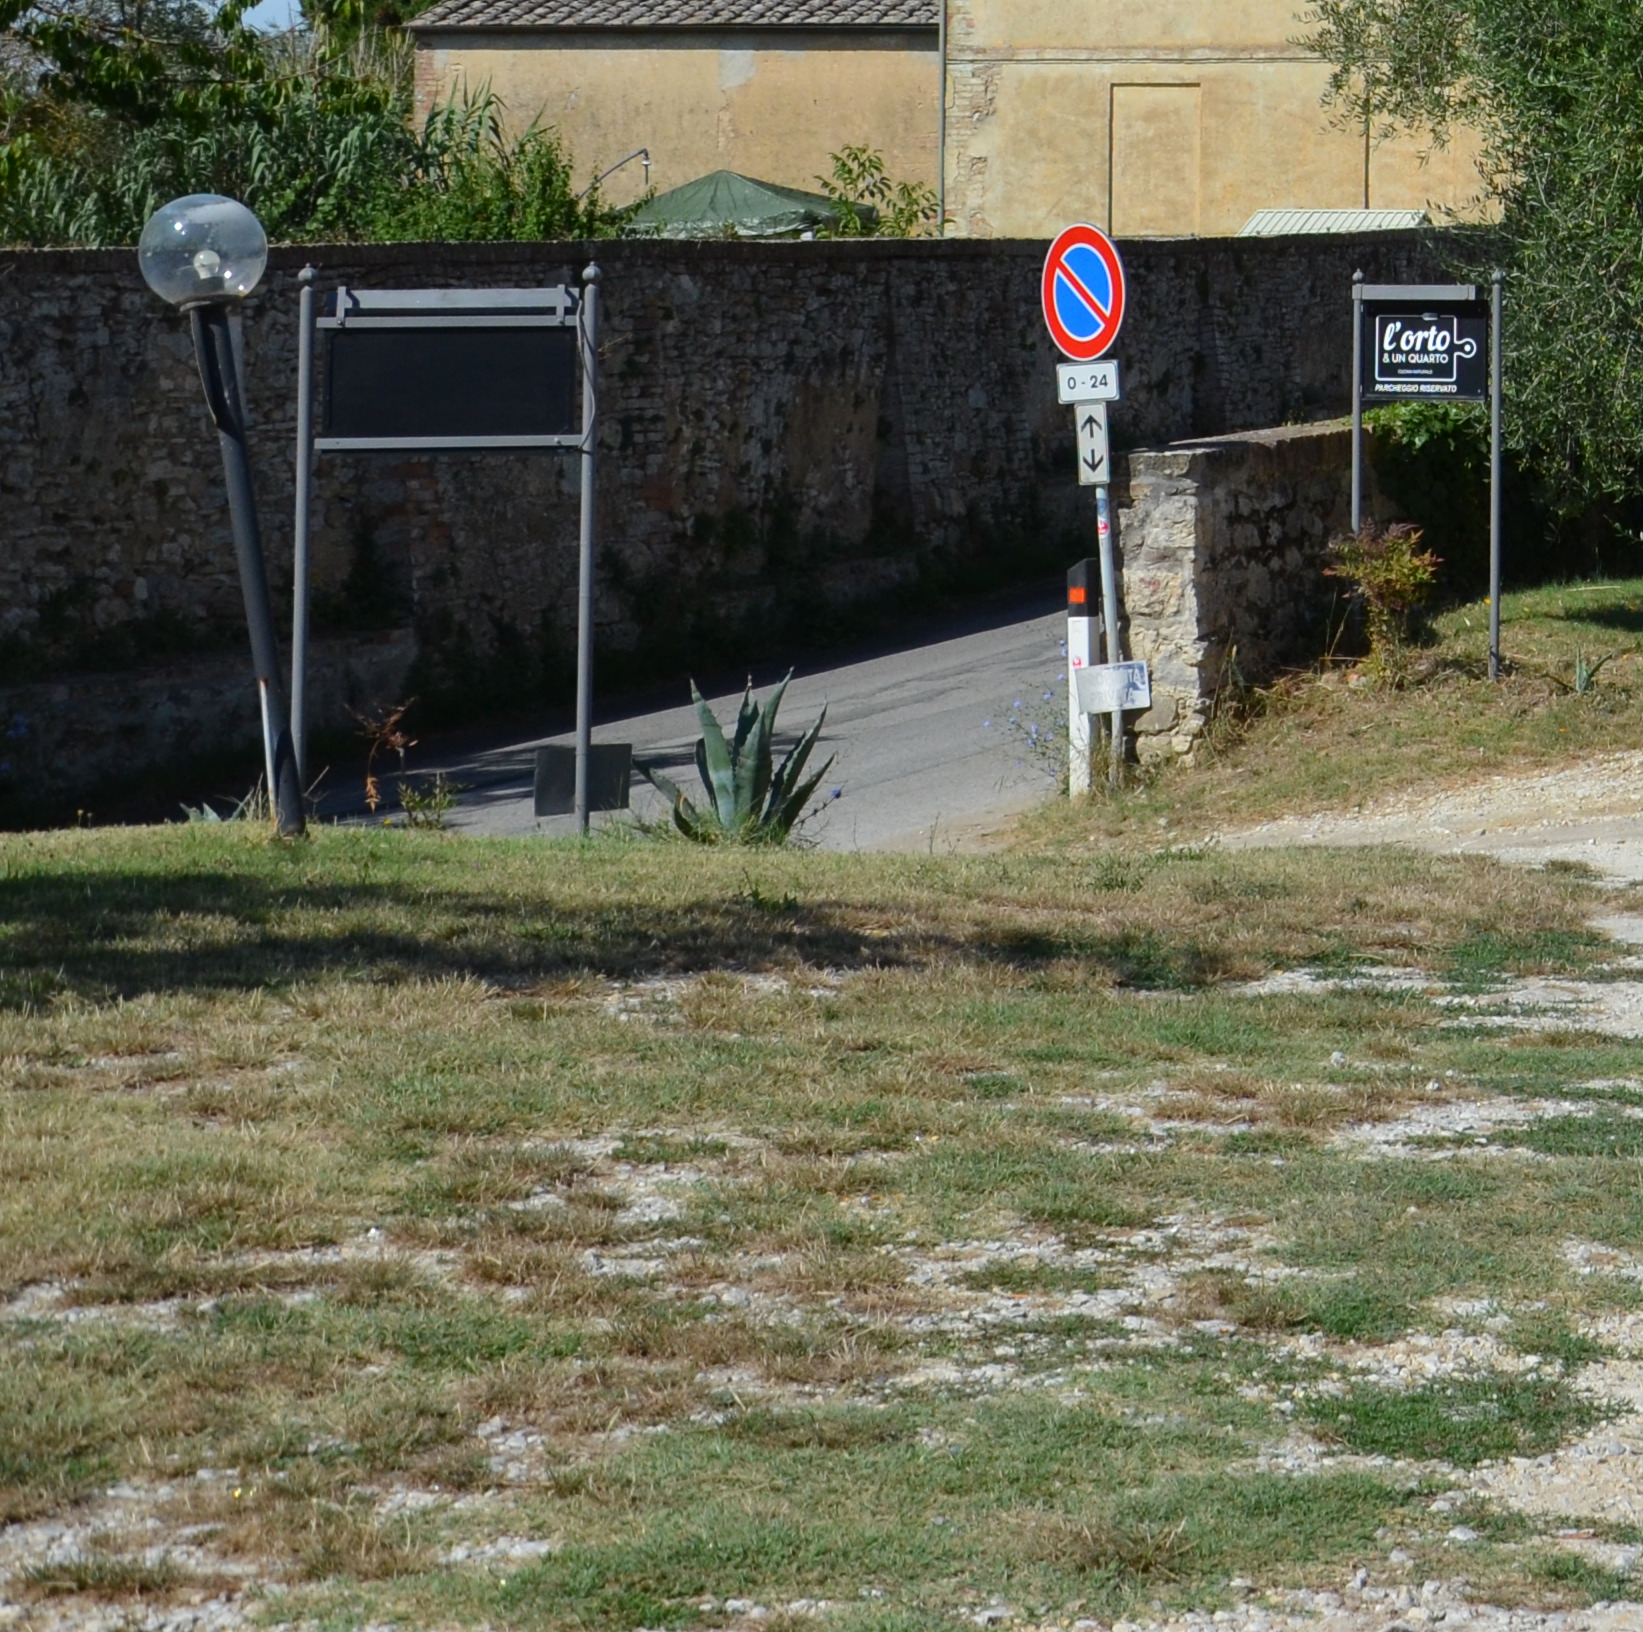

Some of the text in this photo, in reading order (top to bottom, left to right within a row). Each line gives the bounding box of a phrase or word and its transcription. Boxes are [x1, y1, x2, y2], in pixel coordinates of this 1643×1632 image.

[1391, 353, 1406, 363] UN
[1408, 353, 1449, 364] QUARTO
[1067, 376, 1077, 390] 0
[1089, 374, 1108, 388] 24
